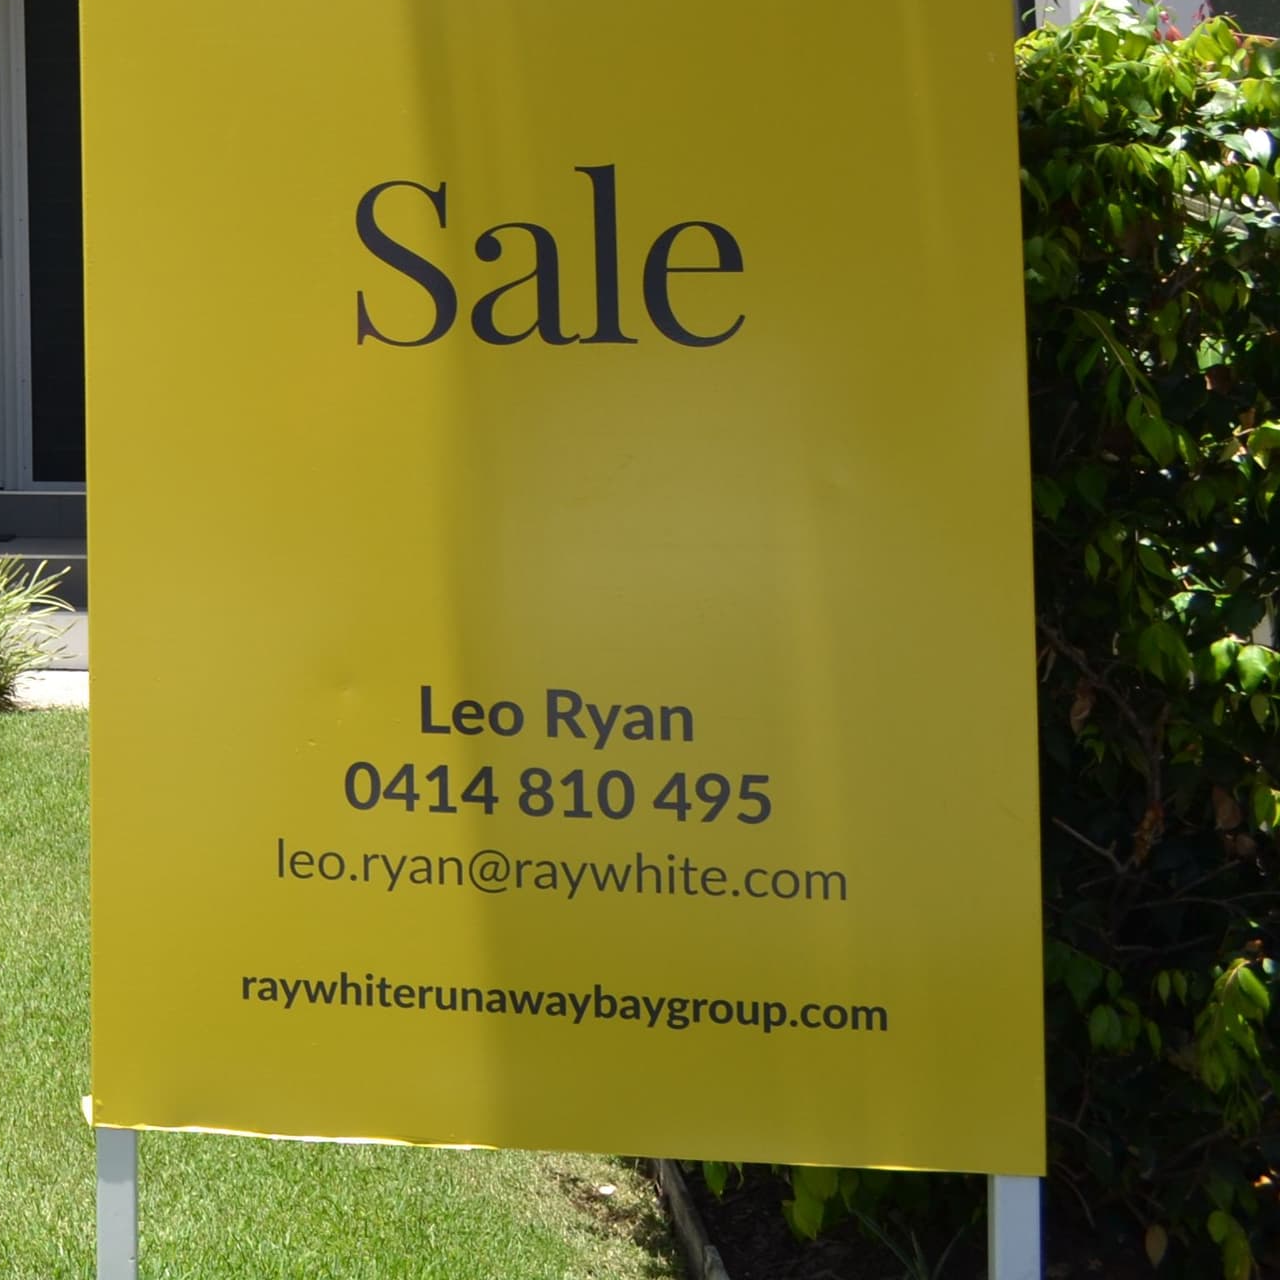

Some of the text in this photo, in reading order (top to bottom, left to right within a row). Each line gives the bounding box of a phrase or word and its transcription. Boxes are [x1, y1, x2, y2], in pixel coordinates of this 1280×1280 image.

[355, 163, 745, 348] Sale
[419, 684, 694, 750] Leo Ryan
[343, 760, 773, 825] 0414 810 495
[276, 837, 848, 901] leo.ryan@raywhite.com
[241, 971, 889, 1033] raywhiterunawaybaygroup.com
